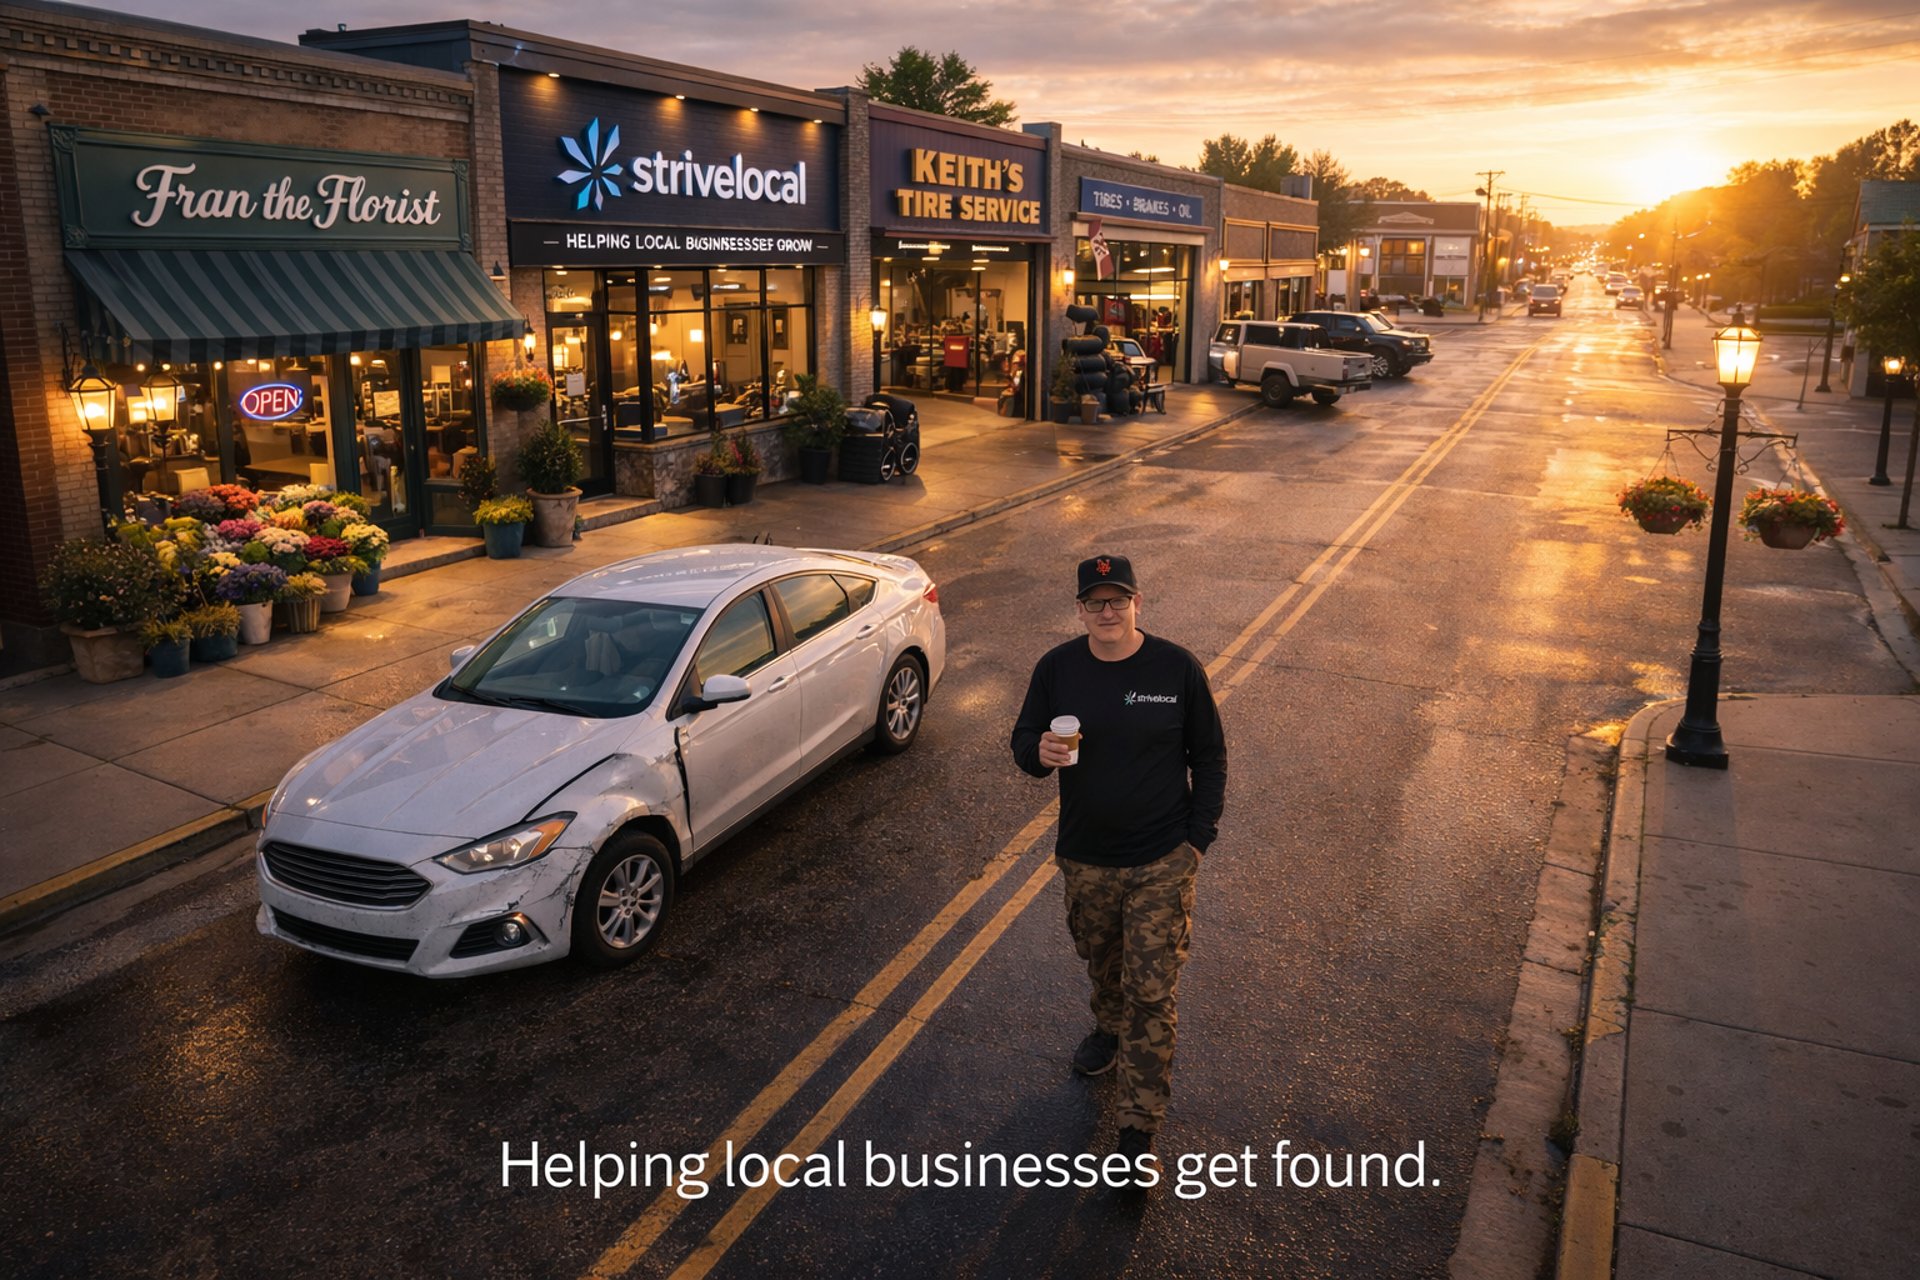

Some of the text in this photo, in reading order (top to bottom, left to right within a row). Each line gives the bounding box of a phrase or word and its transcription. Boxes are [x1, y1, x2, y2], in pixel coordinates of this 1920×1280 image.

[631, 150, 806, 205] strivelocal
[912, 148, 1024, 193] KEITH'S
[131, 163, 441, 229] Fran the Florist
[896, 188, 1040, 224] TIRE SERVICE
[566, 233, 630, 249] HELPING
[635, 235, 681, 250] LOCAL
[242, 388, 298, 414] OPEN
